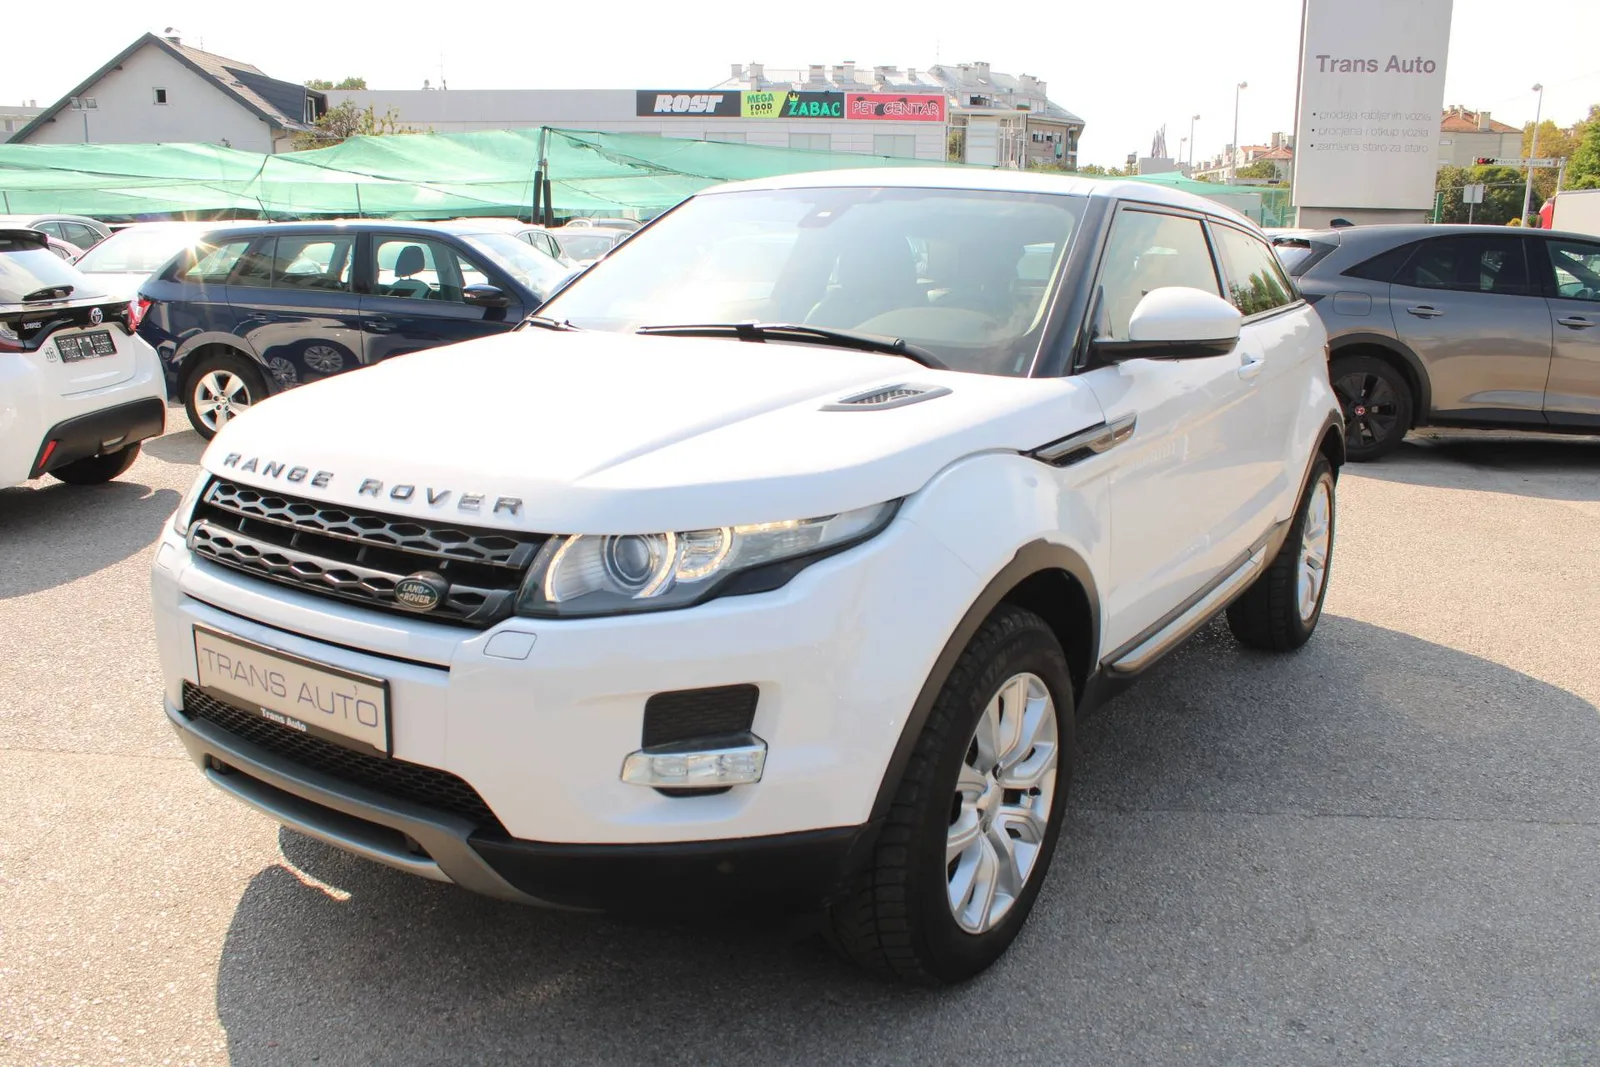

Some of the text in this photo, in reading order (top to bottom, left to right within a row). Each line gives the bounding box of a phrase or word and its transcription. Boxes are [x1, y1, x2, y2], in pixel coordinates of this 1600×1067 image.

[1316, 54, 1437, 74] Trans Auto
[746, 93, 774, 104] MEGA
[750, 103, 773, 111] FOOD
[852, 101, 939, 116] PET CENTAR
[1319, 110, 1358, 121] prodaja
[1404, 111, 1432, 121] vozila
[1370, 126, 1400, 137] otkup
[1402, 127, 1429, 138] vozila
[1362, 142, 1388, 152] staro
[1389, 143, 1401, 152] za
[1404, 143, 1429, 153] staro
[223, 452, 523, 516] RANGE ROVER
[402, 583, 425, 594] LAND
[403, 592, 430, 604] ROVER
[202, 647, 379, 728] TRANS AUTO
[260, 707, 307, 732] Trans Auto
